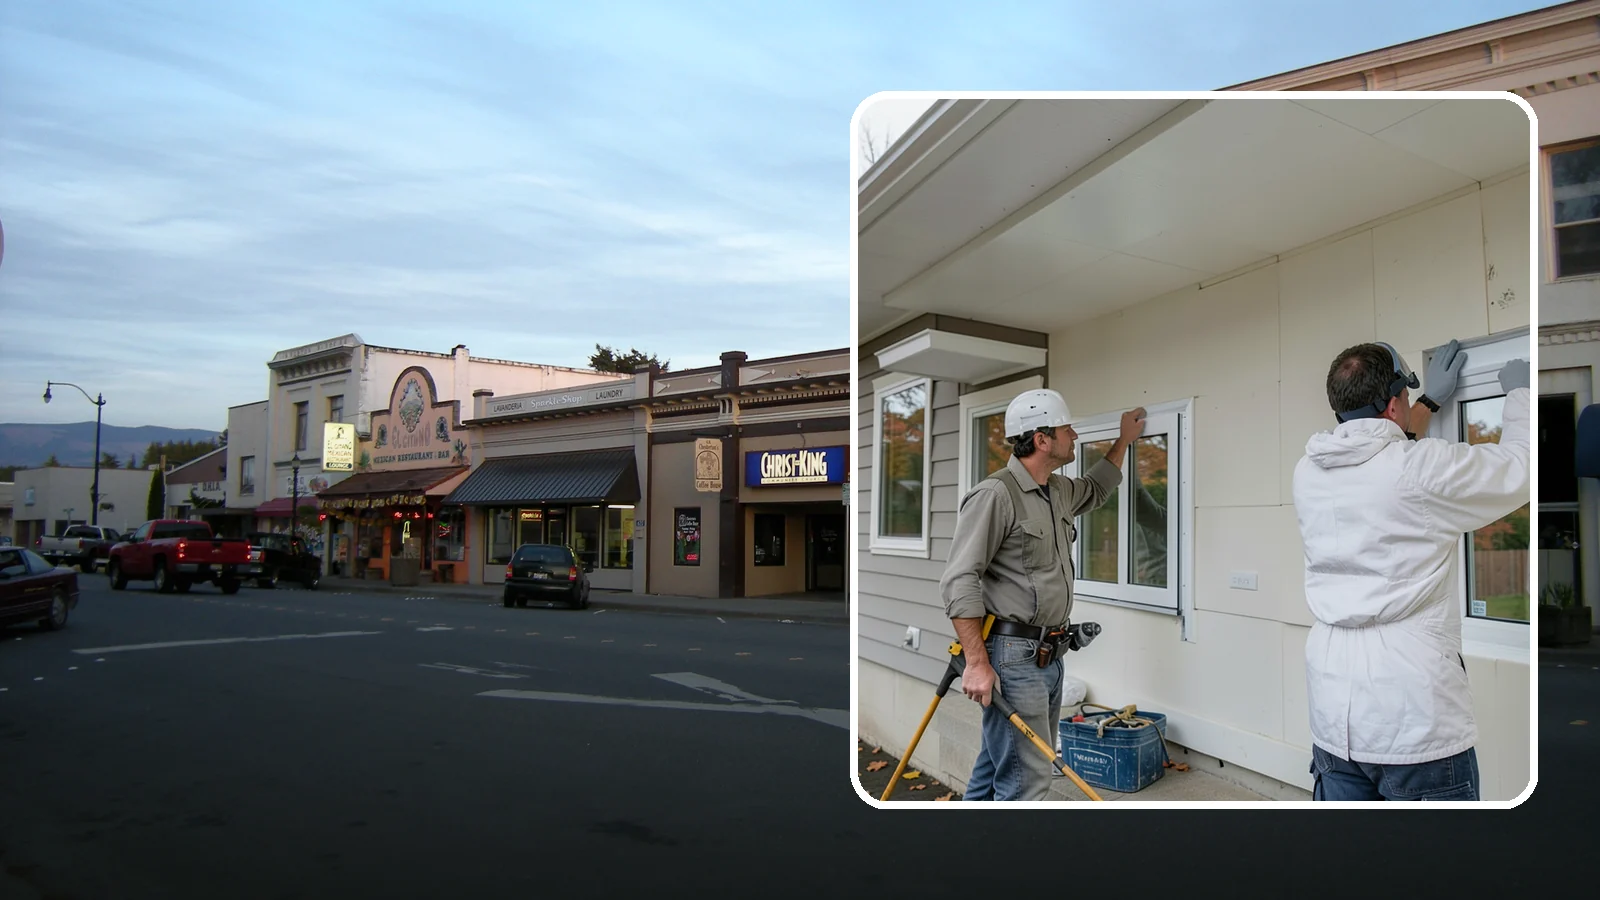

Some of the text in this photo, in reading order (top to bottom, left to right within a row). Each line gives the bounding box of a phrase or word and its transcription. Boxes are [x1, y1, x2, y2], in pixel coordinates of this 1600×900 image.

[561, 394, 583, 406] Shop
[595, 389, 624, 400] LAUNDRY
[493, 401, 523, 413] LAVANDERIA
[373, 454, 396, 464] MEXICAN
[398, 451, 433, 462] RESTAURANT
[438, 450, 450, 459] BAR
[761, 450, 828, 478] CHRIST KING
